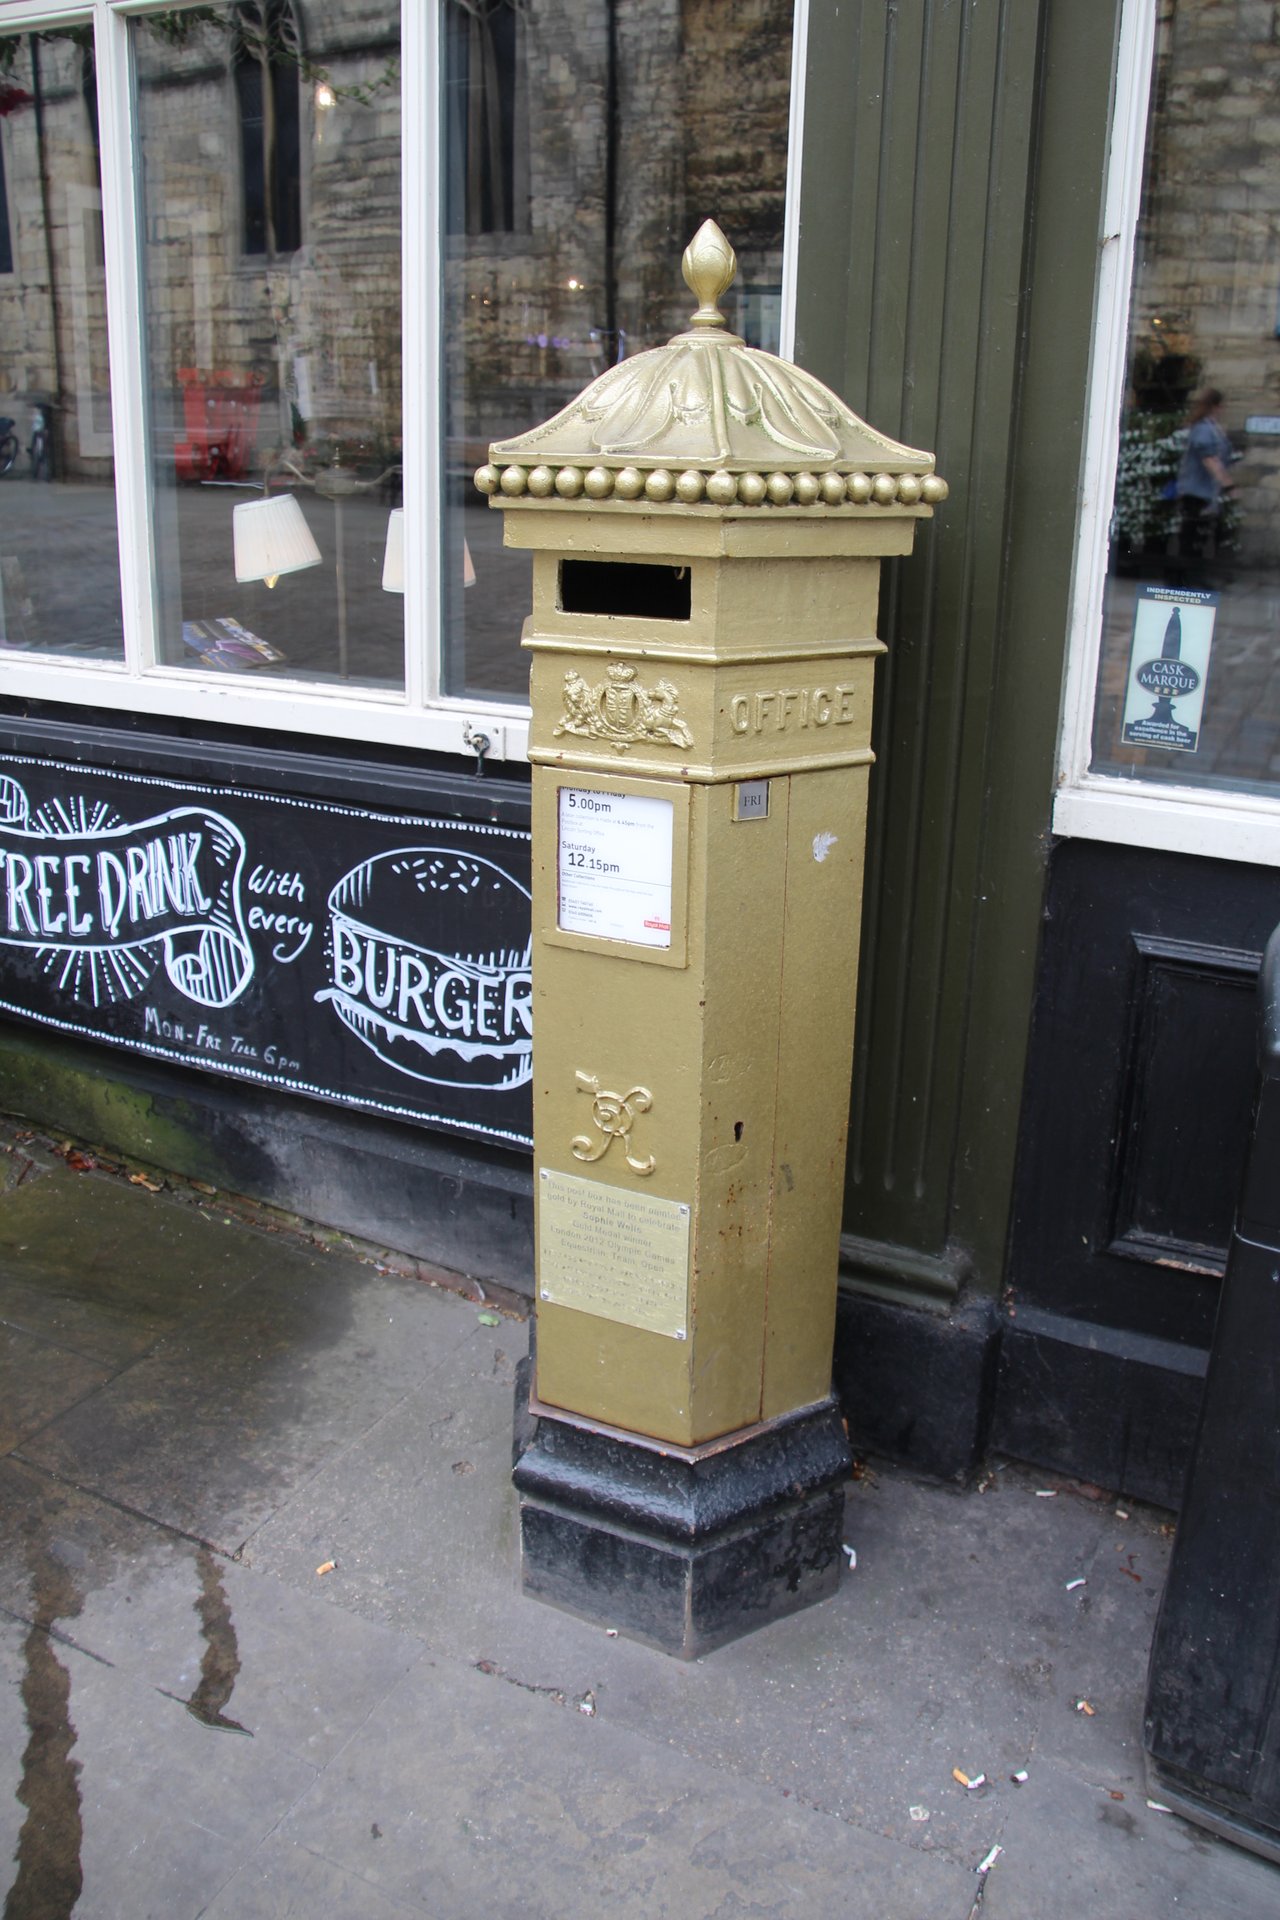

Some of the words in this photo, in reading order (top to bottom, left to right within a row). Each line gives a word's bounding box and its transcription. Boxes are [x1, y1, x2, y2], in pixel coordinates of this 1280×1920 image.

[1146, 586, 1211, 599] INDEPENDENTLY
[1154, 593, 1202, 604] INSPECTED
[1152, 662, 1186, 676] CASK
[1140, 673, 1196, 690] MARQUE
[729, 683, 856, 735] OFFICE
[1129, 731, 1152, 739] serving
[568, 793, 612, 813] 5.00pm
[743, 794, 762, 807] FRI
[561, 840, 596, 854] Saturday
[567, 852, 620, 873] 12.15pm
[96, 832, 212, 940] DRINK
[248, 864, 305, 902] With
[248, 905, 314, 963] every
[547, 1181, 565, 1192] This
[567, 1185, 585, 1197] post
[588, 1191, 603, 1201] box
[606, 1195, 622, 1205] has
[624, 1200, 646, 1211] been
[547, 1192, 565, 1203] gold
[567, 1197, 578, 1207] by
[580, 1200, 605, 1213] Royal
[607, 1207, 625, 1218] Mail
[628, 1212, 637, 1221] to
[639, 1215, 682, 1233] celebrate
[582, 1212, 614, 1227] Sophie
[617, 1220, 643, 1234] Wells
[572, 1219, 592, 1231] Gold
[594, 1225, 621, 1239] Medal
[623, 1234, 652, 1247] winner
[550, 1225, 581, 1240] London
[584, 1234, 605, 1246] 2012
[644, 1248, 675, 1264] Games
[641, 1260, 665, 1274] Open
